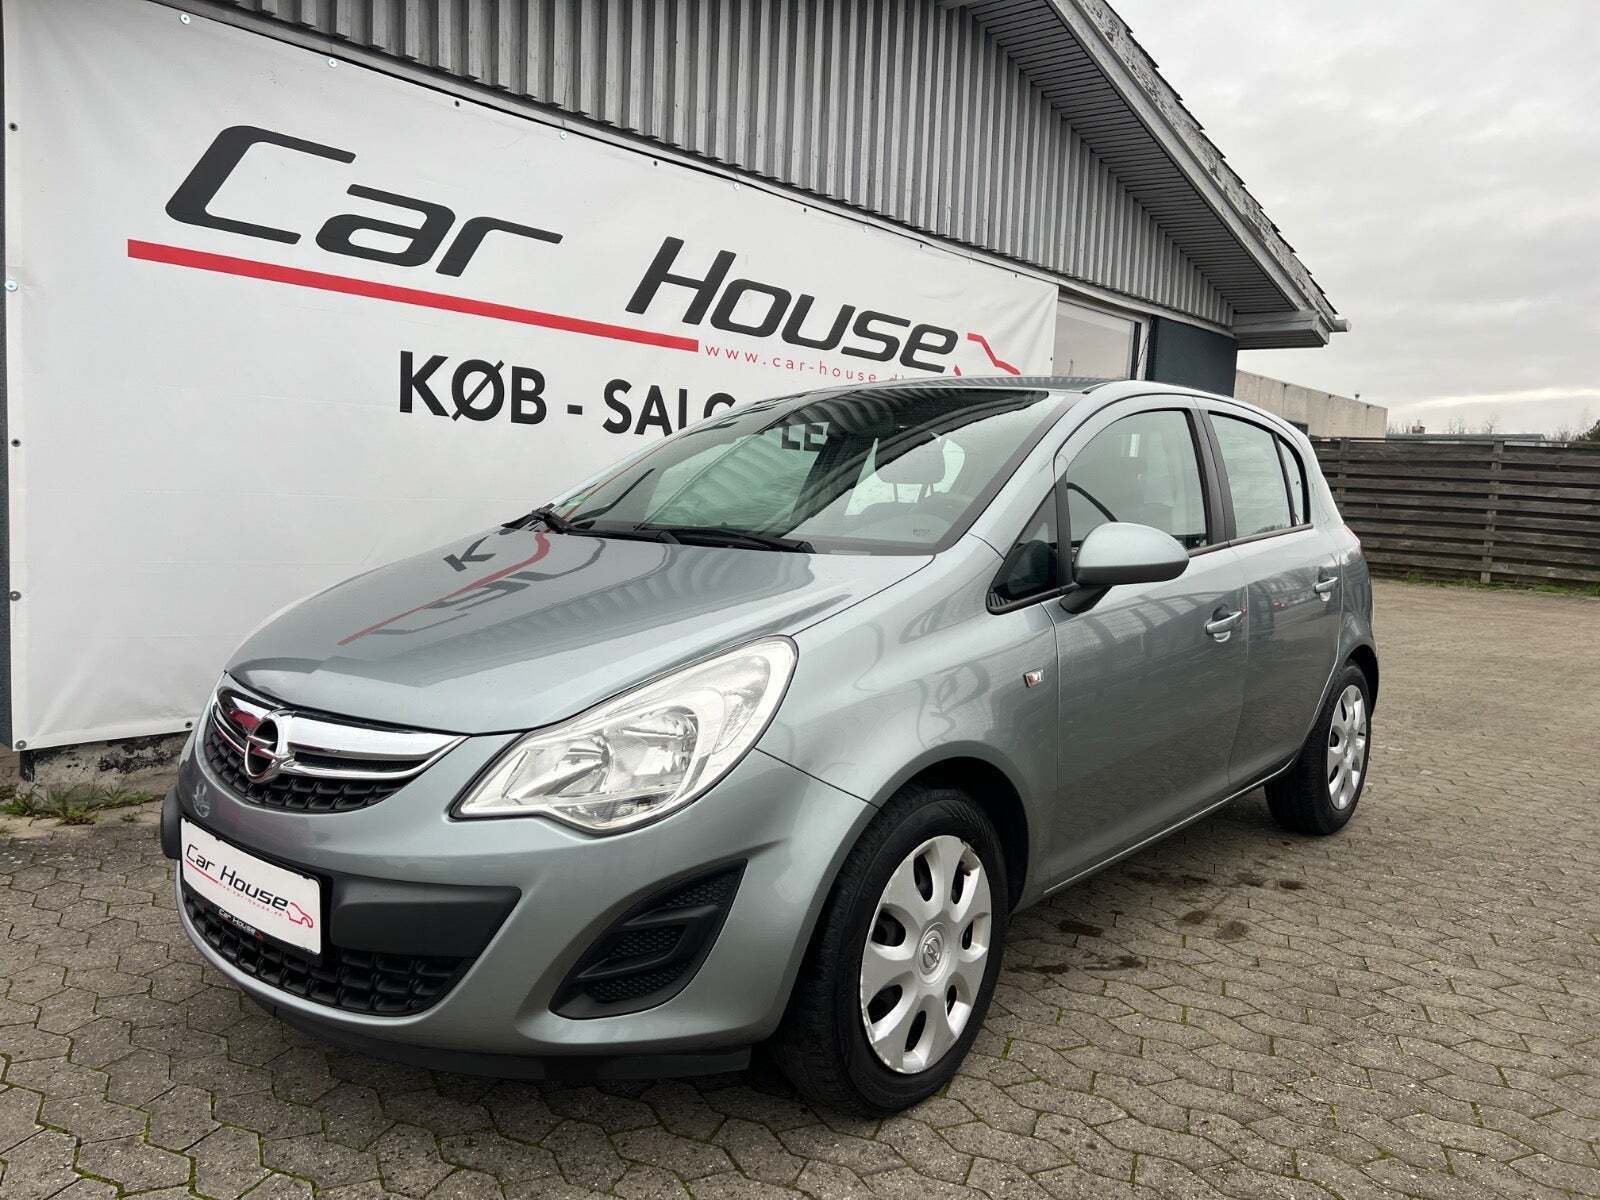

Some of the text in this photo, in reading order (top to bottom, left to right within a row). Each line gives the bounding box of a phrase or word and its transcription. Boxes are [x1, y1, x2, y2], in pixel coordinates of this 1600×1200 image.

[164, 125, 959, 374] Car House
[399, 350, 547, 425] KØB
[705, 344, 904, 383] www.car-house
[186, 843, 216, 871] Car
[220, 865, 289, 911] House
